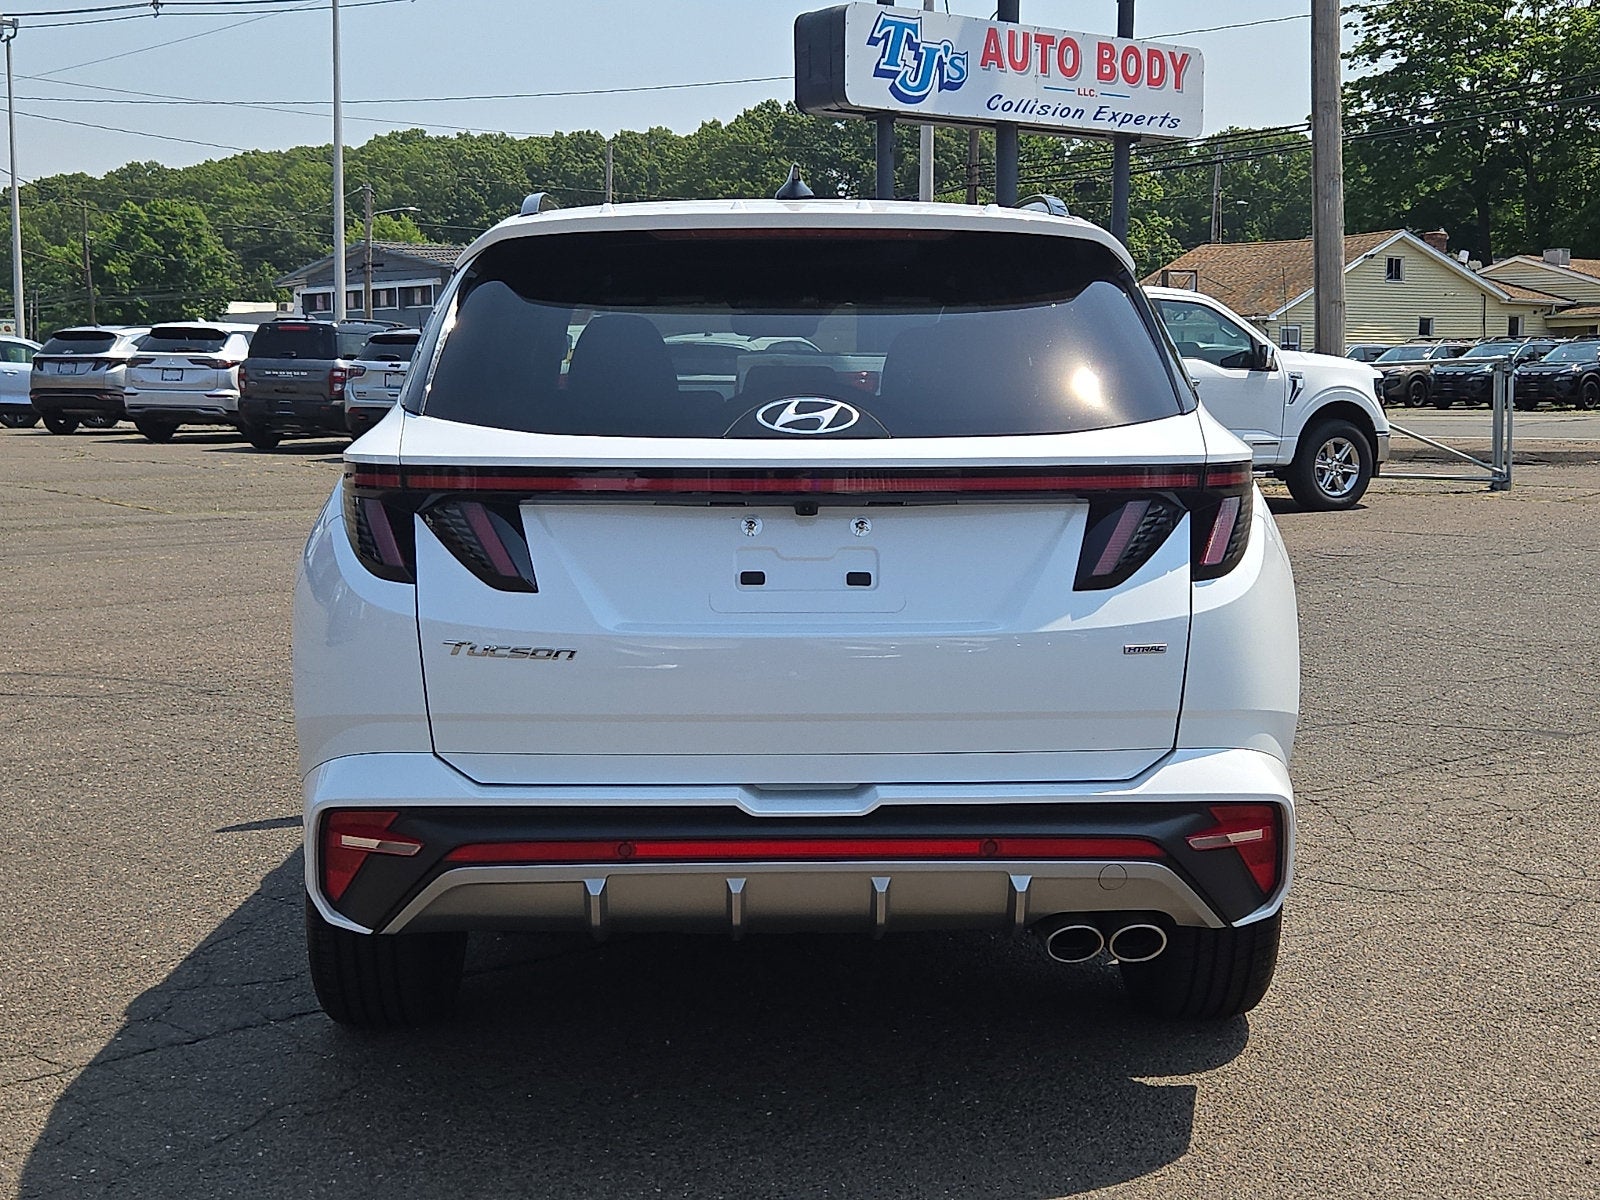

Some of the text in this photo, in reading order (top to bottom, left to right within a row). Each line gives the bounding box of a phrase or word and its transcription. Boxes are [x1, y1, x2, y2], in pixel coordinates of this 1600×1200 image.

[866, 11, 1190, 105] TJ's AUTO BODY
[1077, 87, 1099, 98] LLC.
[986, 94, 1181, 129] Collision Experts
[1127, 645, 1166, 653] HTRAC
